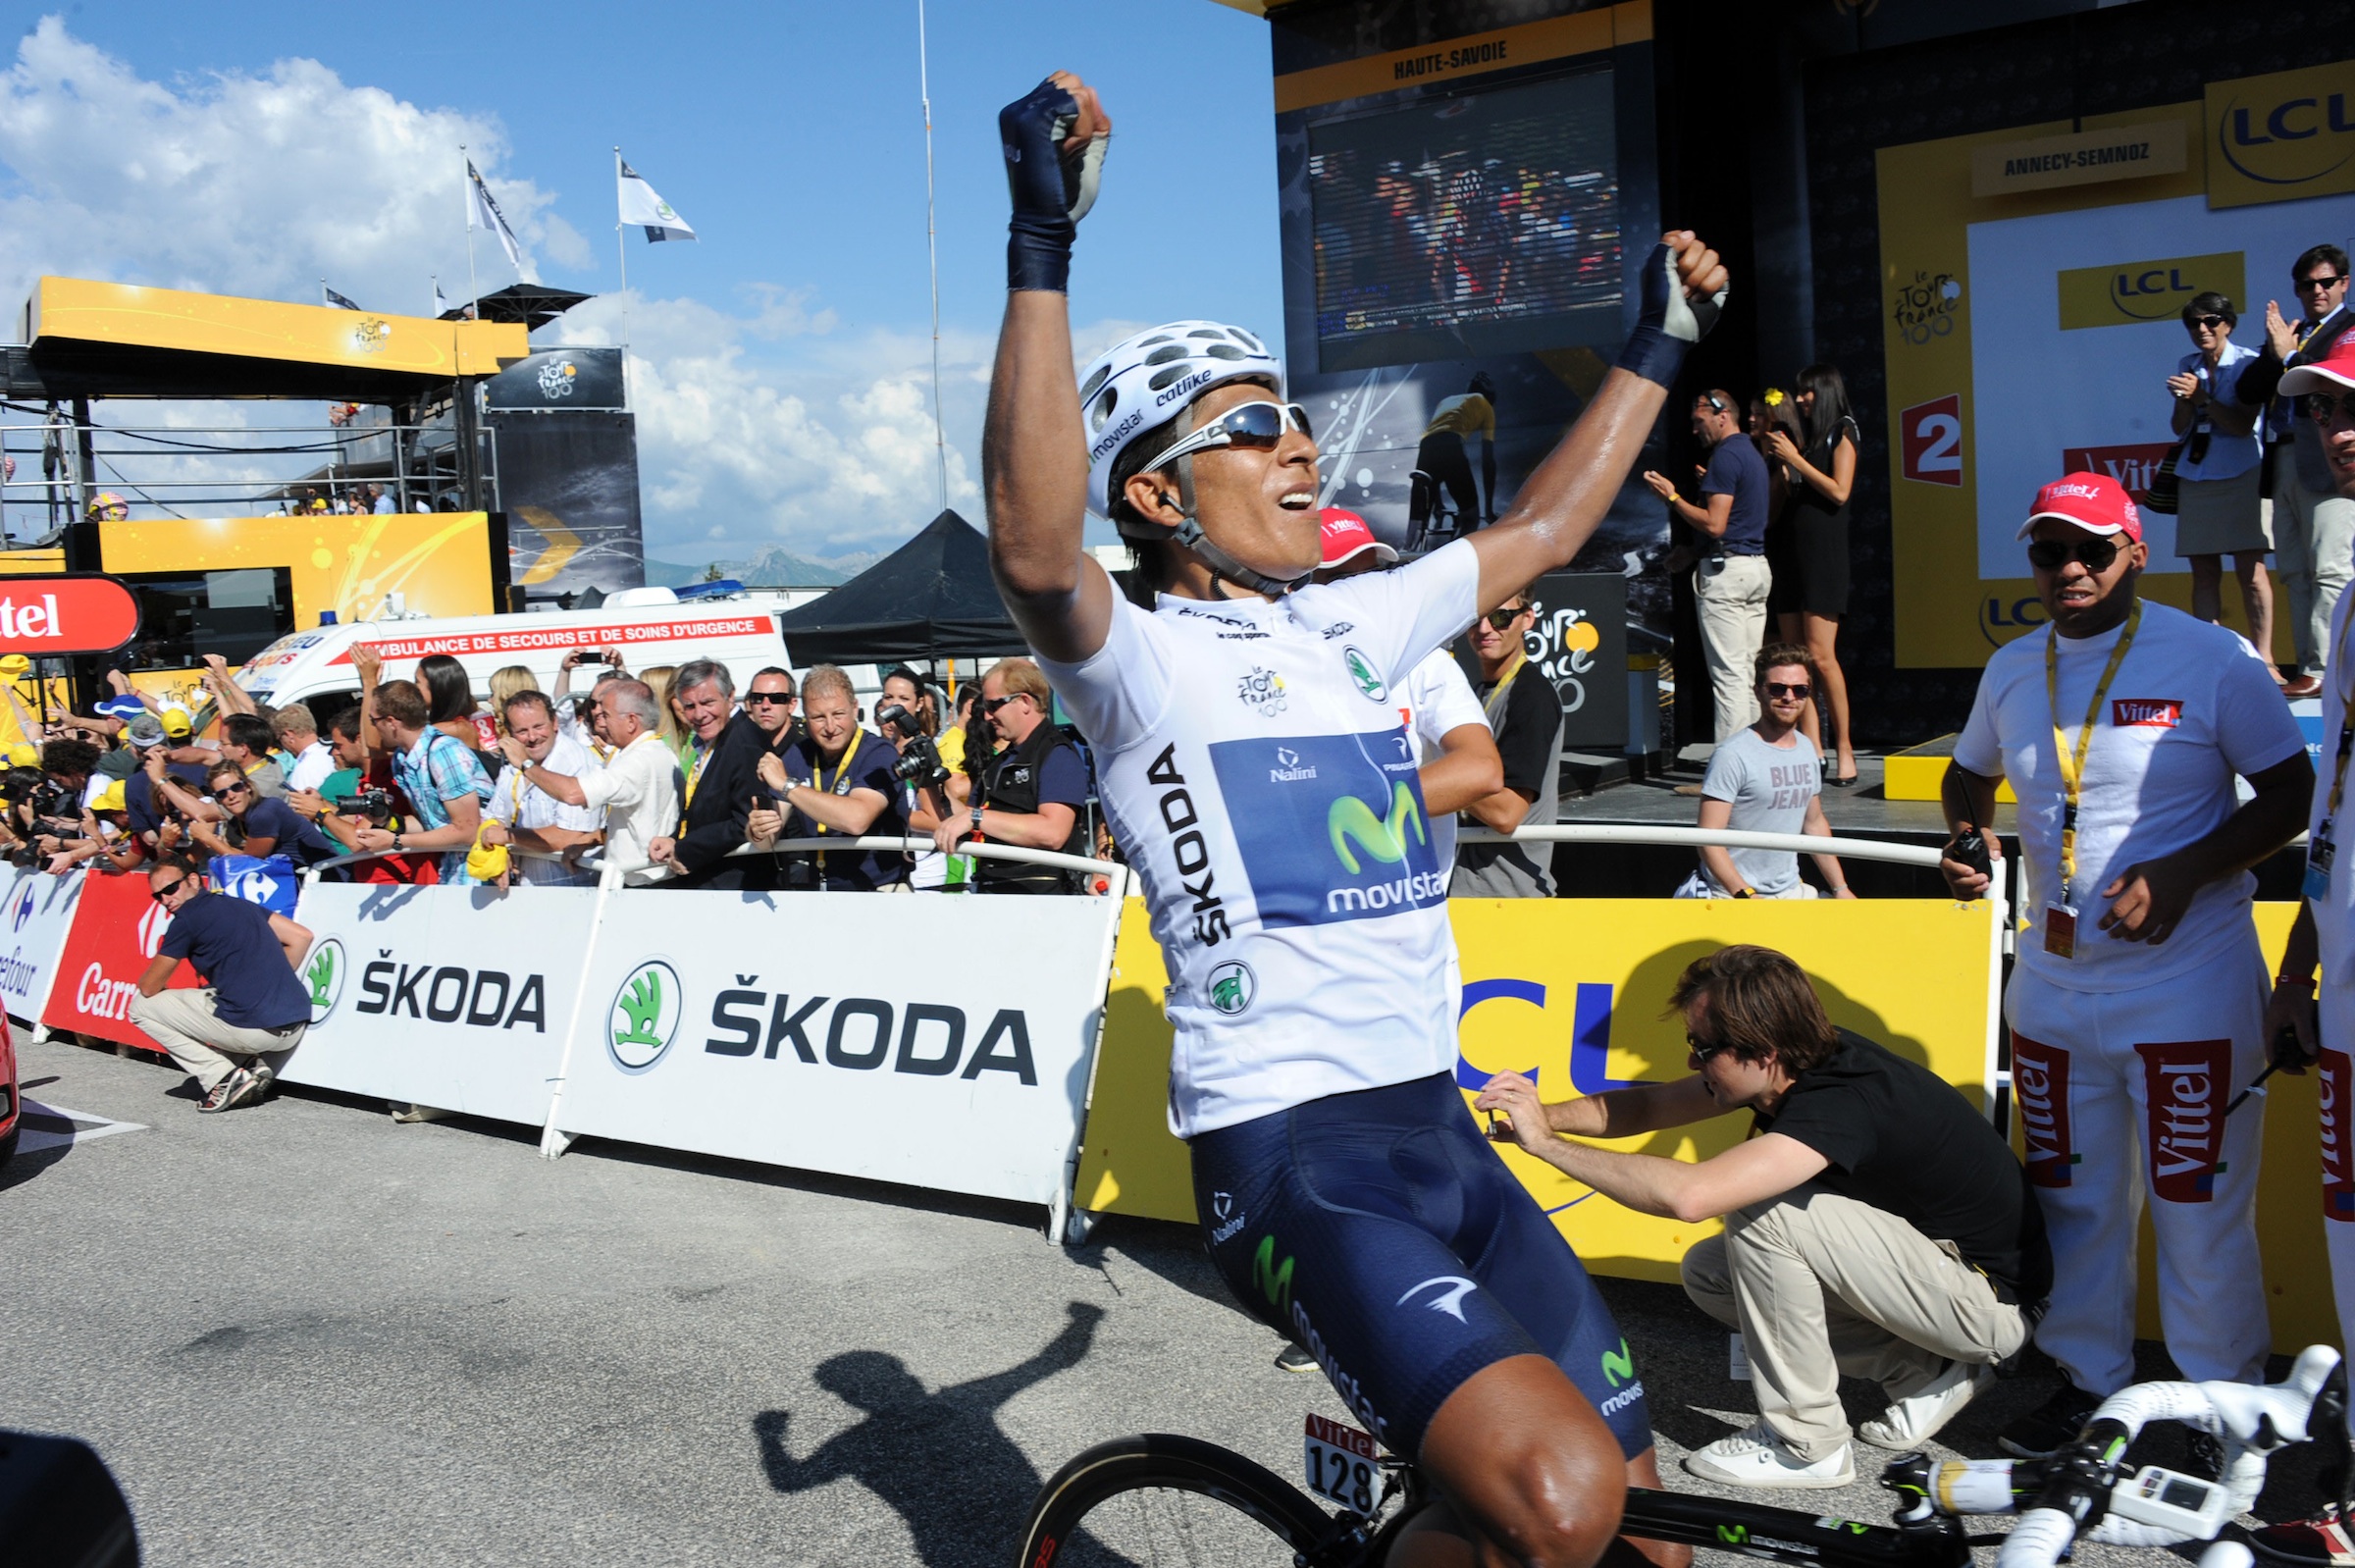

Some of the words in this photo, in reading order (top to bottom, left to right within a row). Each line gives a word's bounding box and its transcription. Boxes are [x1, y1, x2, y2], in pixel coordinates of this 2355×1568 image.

[1394, 40, 1507, 79] HAUTE-SAVOIE
[2234, 93, 2355, 146] LCL
[2005, 142, 2149, 177] ANNECY-SEMNOZ
[2118, 267, 2195, 296] LCL
[1902, 314, 1955, 345] 100
[1156, 369, 1213, 408] catlike
[1094, 408, 1144, 460] movistar
[1915, 412, 1962, 473] 2
[2103, 457, 2164, 492] Vit
[0, 593, 64, 639] tel
[473, 637, 497, 652] DE
[498, 632, 576, 650] SECOURS
[578, 630, 598, 644] ET
[601, 628, 623, 642] DE
[625, 624, 669, 639] SOINS
[672, 619, 756, 638] D'URGENCE
[2118, 702, 2173, 724] Vittel
[1270, 765, 1318, 783] Nalini
[1770, 763, 1812, 788] BLUE
[1146, 741, 1231, 948] ŠKODA
[1327, 869, 1443, 914] movista
[77, 962, 137, 1021] Carr
[356, 948, 547, 1034] ŠKODA
[704, 973, 1039, 1086] ŠKODA
[1457, 977, 1670, 1096] CL
[2015, 1053, 2061, 1164] Vittel
[2157, 1060, 2212, 1178] Vittel
[1309, 1444, 1373, 1514] 128
